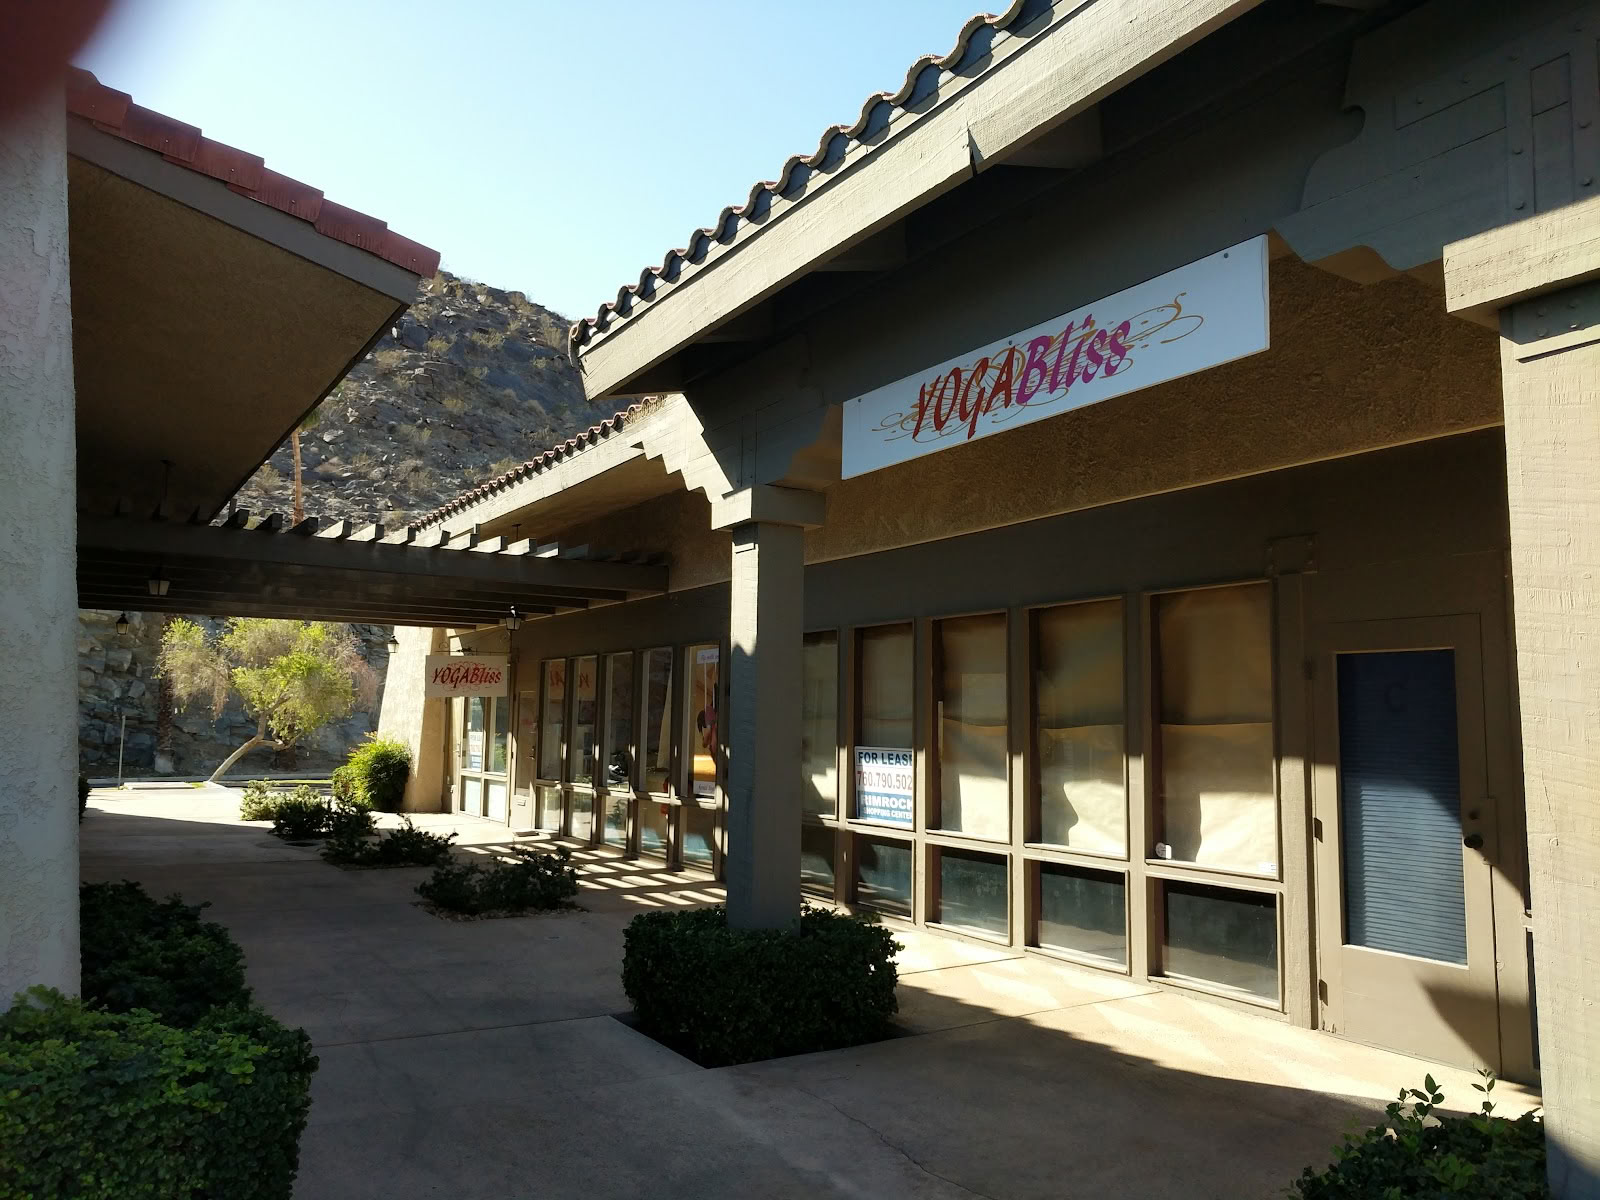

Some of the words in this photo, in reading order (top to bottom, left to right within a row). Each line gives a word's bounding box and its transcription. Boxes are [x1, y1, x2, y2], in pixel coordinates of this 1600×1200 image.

[912, 314, 1131, 440] YOGABliss
[433, 666, 502, 689] YOGABliss
[858, 751, 878, 765] FOR
